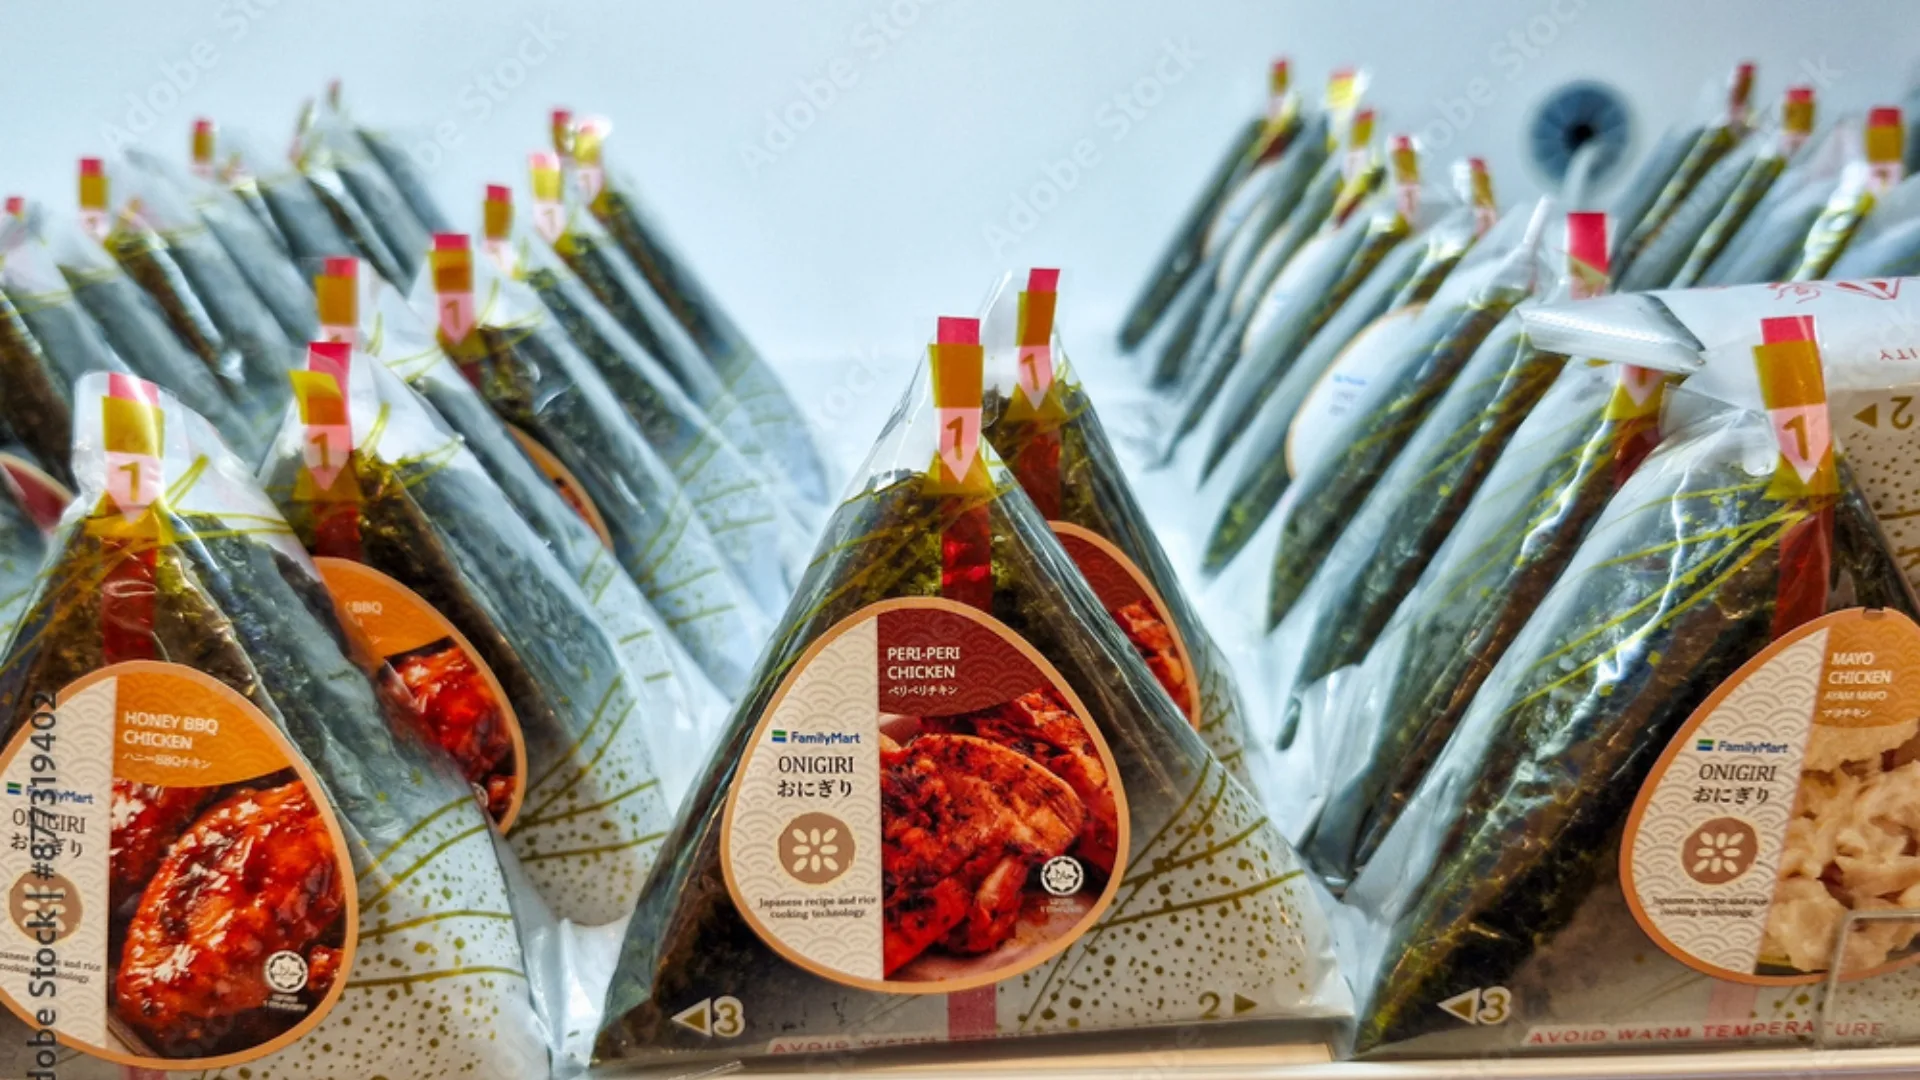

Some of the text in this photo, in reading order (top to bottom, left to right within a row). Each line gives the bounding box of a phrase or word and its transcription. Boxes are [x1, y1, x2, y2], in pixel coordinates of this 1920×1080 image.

[445, 299, 462, 332] 1
[1021, 353, 1040, 391] 1
[1890, 395, 1914, 431] 2
[947, 416, 964, 461] 1
[1782, 414, 1810, 461] 1
[311, 432, 330, 473] 1
[118, 461, 140, 503] 1
[887, 646, 961, 661] PERI-PERI
[1831, 652, 1875, 666] MAYO
[887, 665, 955, 680] CHICKEN
[1828, 670, 1892, 684] CHICKEN
[124, 711, 219, 736] HONEY BBQ
[123, 729, 193, 750] CHICKEN
[791, 731, 860, 745] FamilyMart
[1718, 741, 1788, 754] FamilyMart
[778, 755, 855, 774] ONIGIRI
[1699, 763, 1777, 782] ONIGIRI
[777, 779, 852, 798] おにぎり
[1692, 786, 1769, 805] おにぎり
[760, 896, 877, 908] Japanese recipe and rice
[769, 909, 808, 920] cooking
[1198, 991, 1221, 1019] 2
[1480, 989, 1509, 1023] 3
[716, 999, 742, 1035] 3
[1529, 1030, 1607, 1044] AVOID
[1618, 1026, 1693, 1040] WARM
